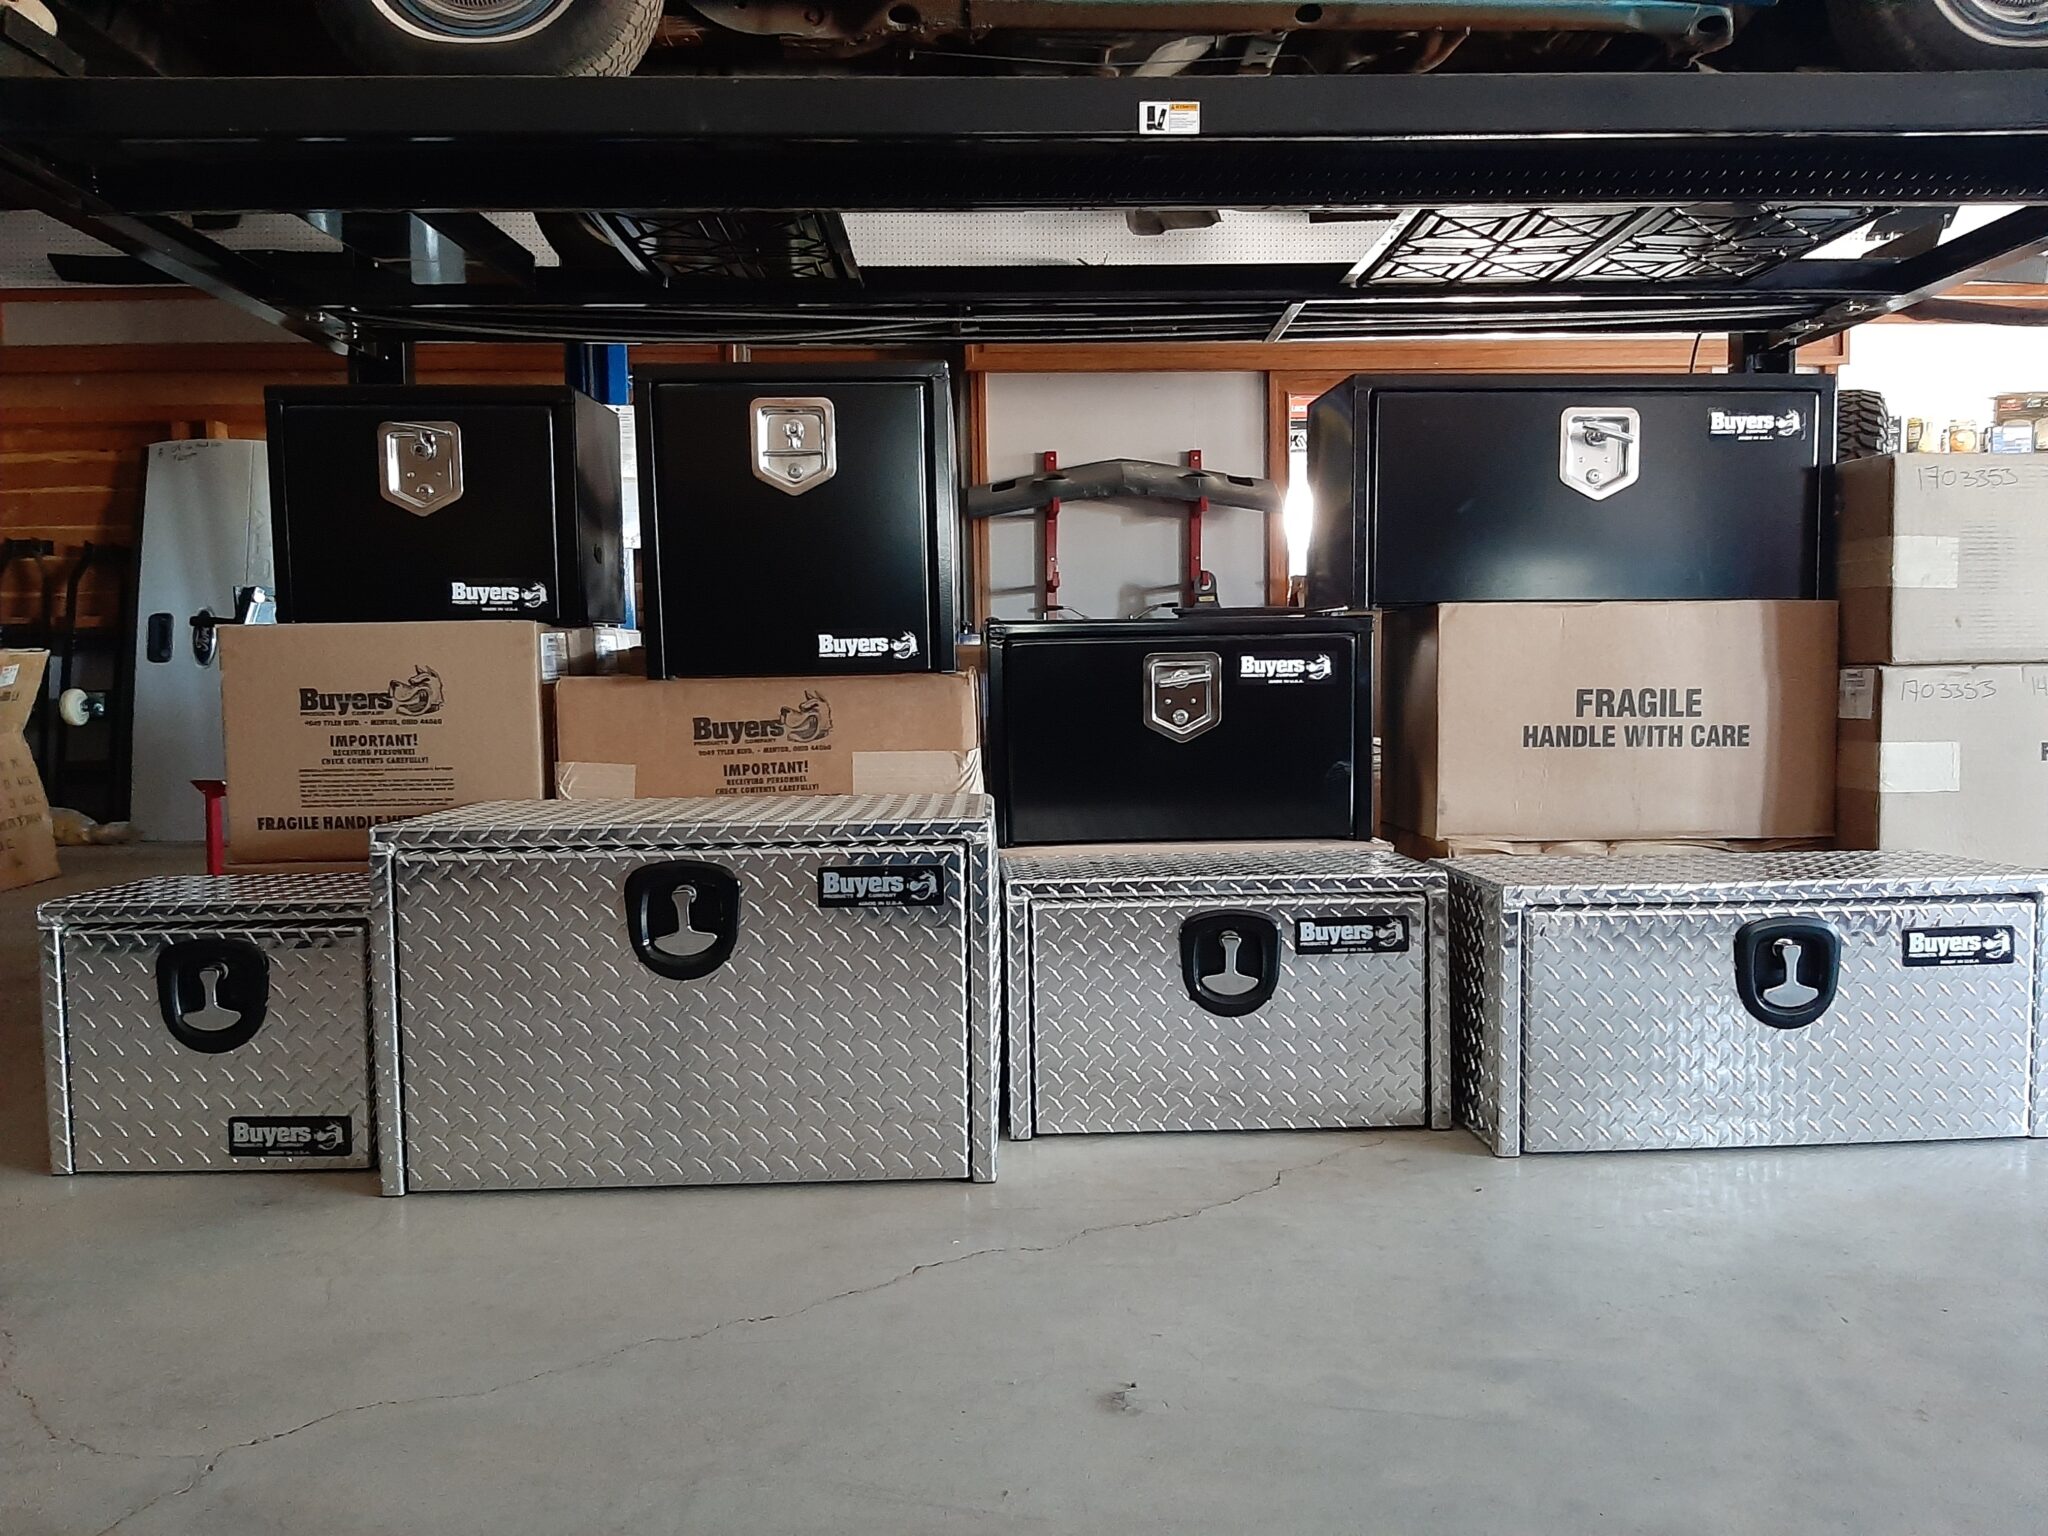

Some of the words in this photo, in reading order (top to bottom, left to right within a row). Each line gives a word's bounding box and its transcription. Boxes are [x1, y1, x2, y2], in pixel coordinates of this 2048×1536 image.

[1710, 411, 1775, 434] Buyers
[1918, 465, 2019, 491] 1703353
[451, 582, 520, 604] Buyers
[818, 634, 889, 657] Buyers
[1240, 655, 1305, 677] Buyers
[299, 688, 393, 715] Buyers
[1901, 679, 1997, 702] 1703353
[1575, 687, 1703, 718] FRAGILE
[330, 734, 418, 747] IMPORTANT!
[693, 717, 785, 745] Buyers
[1522, 724, 1616, 748] HANDLE
[1624, 724, 1684, 748] WITH
[1691, 723, 1750, 748] CARE
[321, 756, 345, 765] CHECK
[347, 756, 384, 765] CONTENTS
[386, 755, 429, 764] CAREFULLY!
[723, 760, 809, 777] IMPORTANT!
[715, 786, 738, 795] CHECK
[740, 784, 776, 794] CONTENTS
[778, 783, 820, 792] CAREFULLY!
[726, 777, 764, 786] RECEIVING
[766, 776, 807, 784] PERSONNEL
[257, 816, 319, 831] FRAGILE
[823, 872, 904, 898] Buyers
[1299, 921, 1374, 945] Buyers
[1908, 932, 1983, 957] Buyers
[233, 1122, 312, 1147] Buyers
